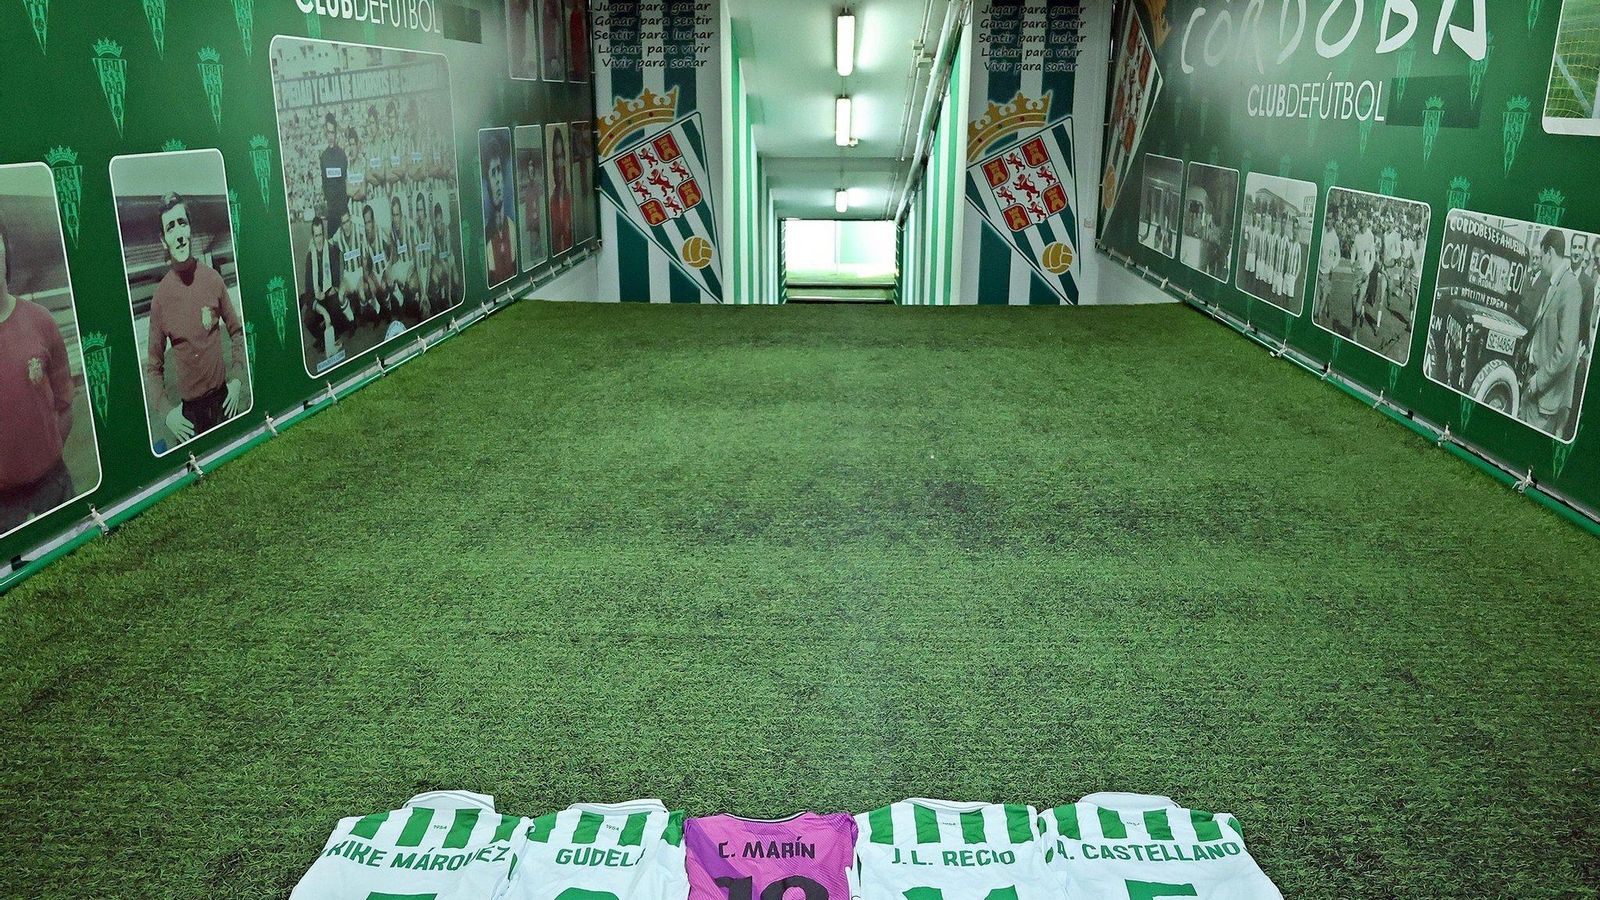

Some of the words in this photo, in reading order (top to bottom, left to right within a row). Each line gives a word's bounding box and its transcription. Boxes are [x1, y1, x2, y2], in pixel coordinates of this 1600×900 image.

[595, 2, 633, 14] Jugar
[636, 4, 667, 14] para
[671, 3, 711, 14] ganar
[981, 5, 1018, 17] Jugar
[1019, 7, 1048, 18] para
[1051, 6, 1086, 18] ganar
[594, 16, 635, 26] Ganar
[636, 17, 669, 28] para
[673, 16, 712, 25] sentir
[980, 19, 1016, 29] Ganar
[1019, 21, 1048, 31] para
[1051, 19, 1086, 29] sentir
[594, 30, 634, 40] Sentir
[638, 31, 669, 42] para
[673, 30, 714, 40] luchar
[979, 33, 1015, 43] Sentir
[1018, 35, 1047, 46] para
[1050, 33, 1086, 44] luchar
[598, 43, 642, 54] Luchar
[646, 45, 678, 57] para
[681, 43, 711, 53] vivir
[981, 47, 1022, 57] Luchar
[1025, 49, 1053, 60] para
[1056, 47, 1082, 57] vivir
[602, 58, 632, 68] Vivir
[636, 60, 667, 71] para
[671, 57, 707, 68] soñar
[984, 61, 1012, 71] Vivir
[1014, 63, 1042, 74] para
[1045, 60, 1078, 72] soñar
[1248, 72, 1385, 122] CLUBDEFÚTBOL
[326, 840, 387, 868] KIKE
[718, 840, 736, 859] C.
[742, 836, 816, 859] MARÍN
[1081, 841, 1241, 862] CASTELLANO
[942, 849, 1016, 867] RECIO
